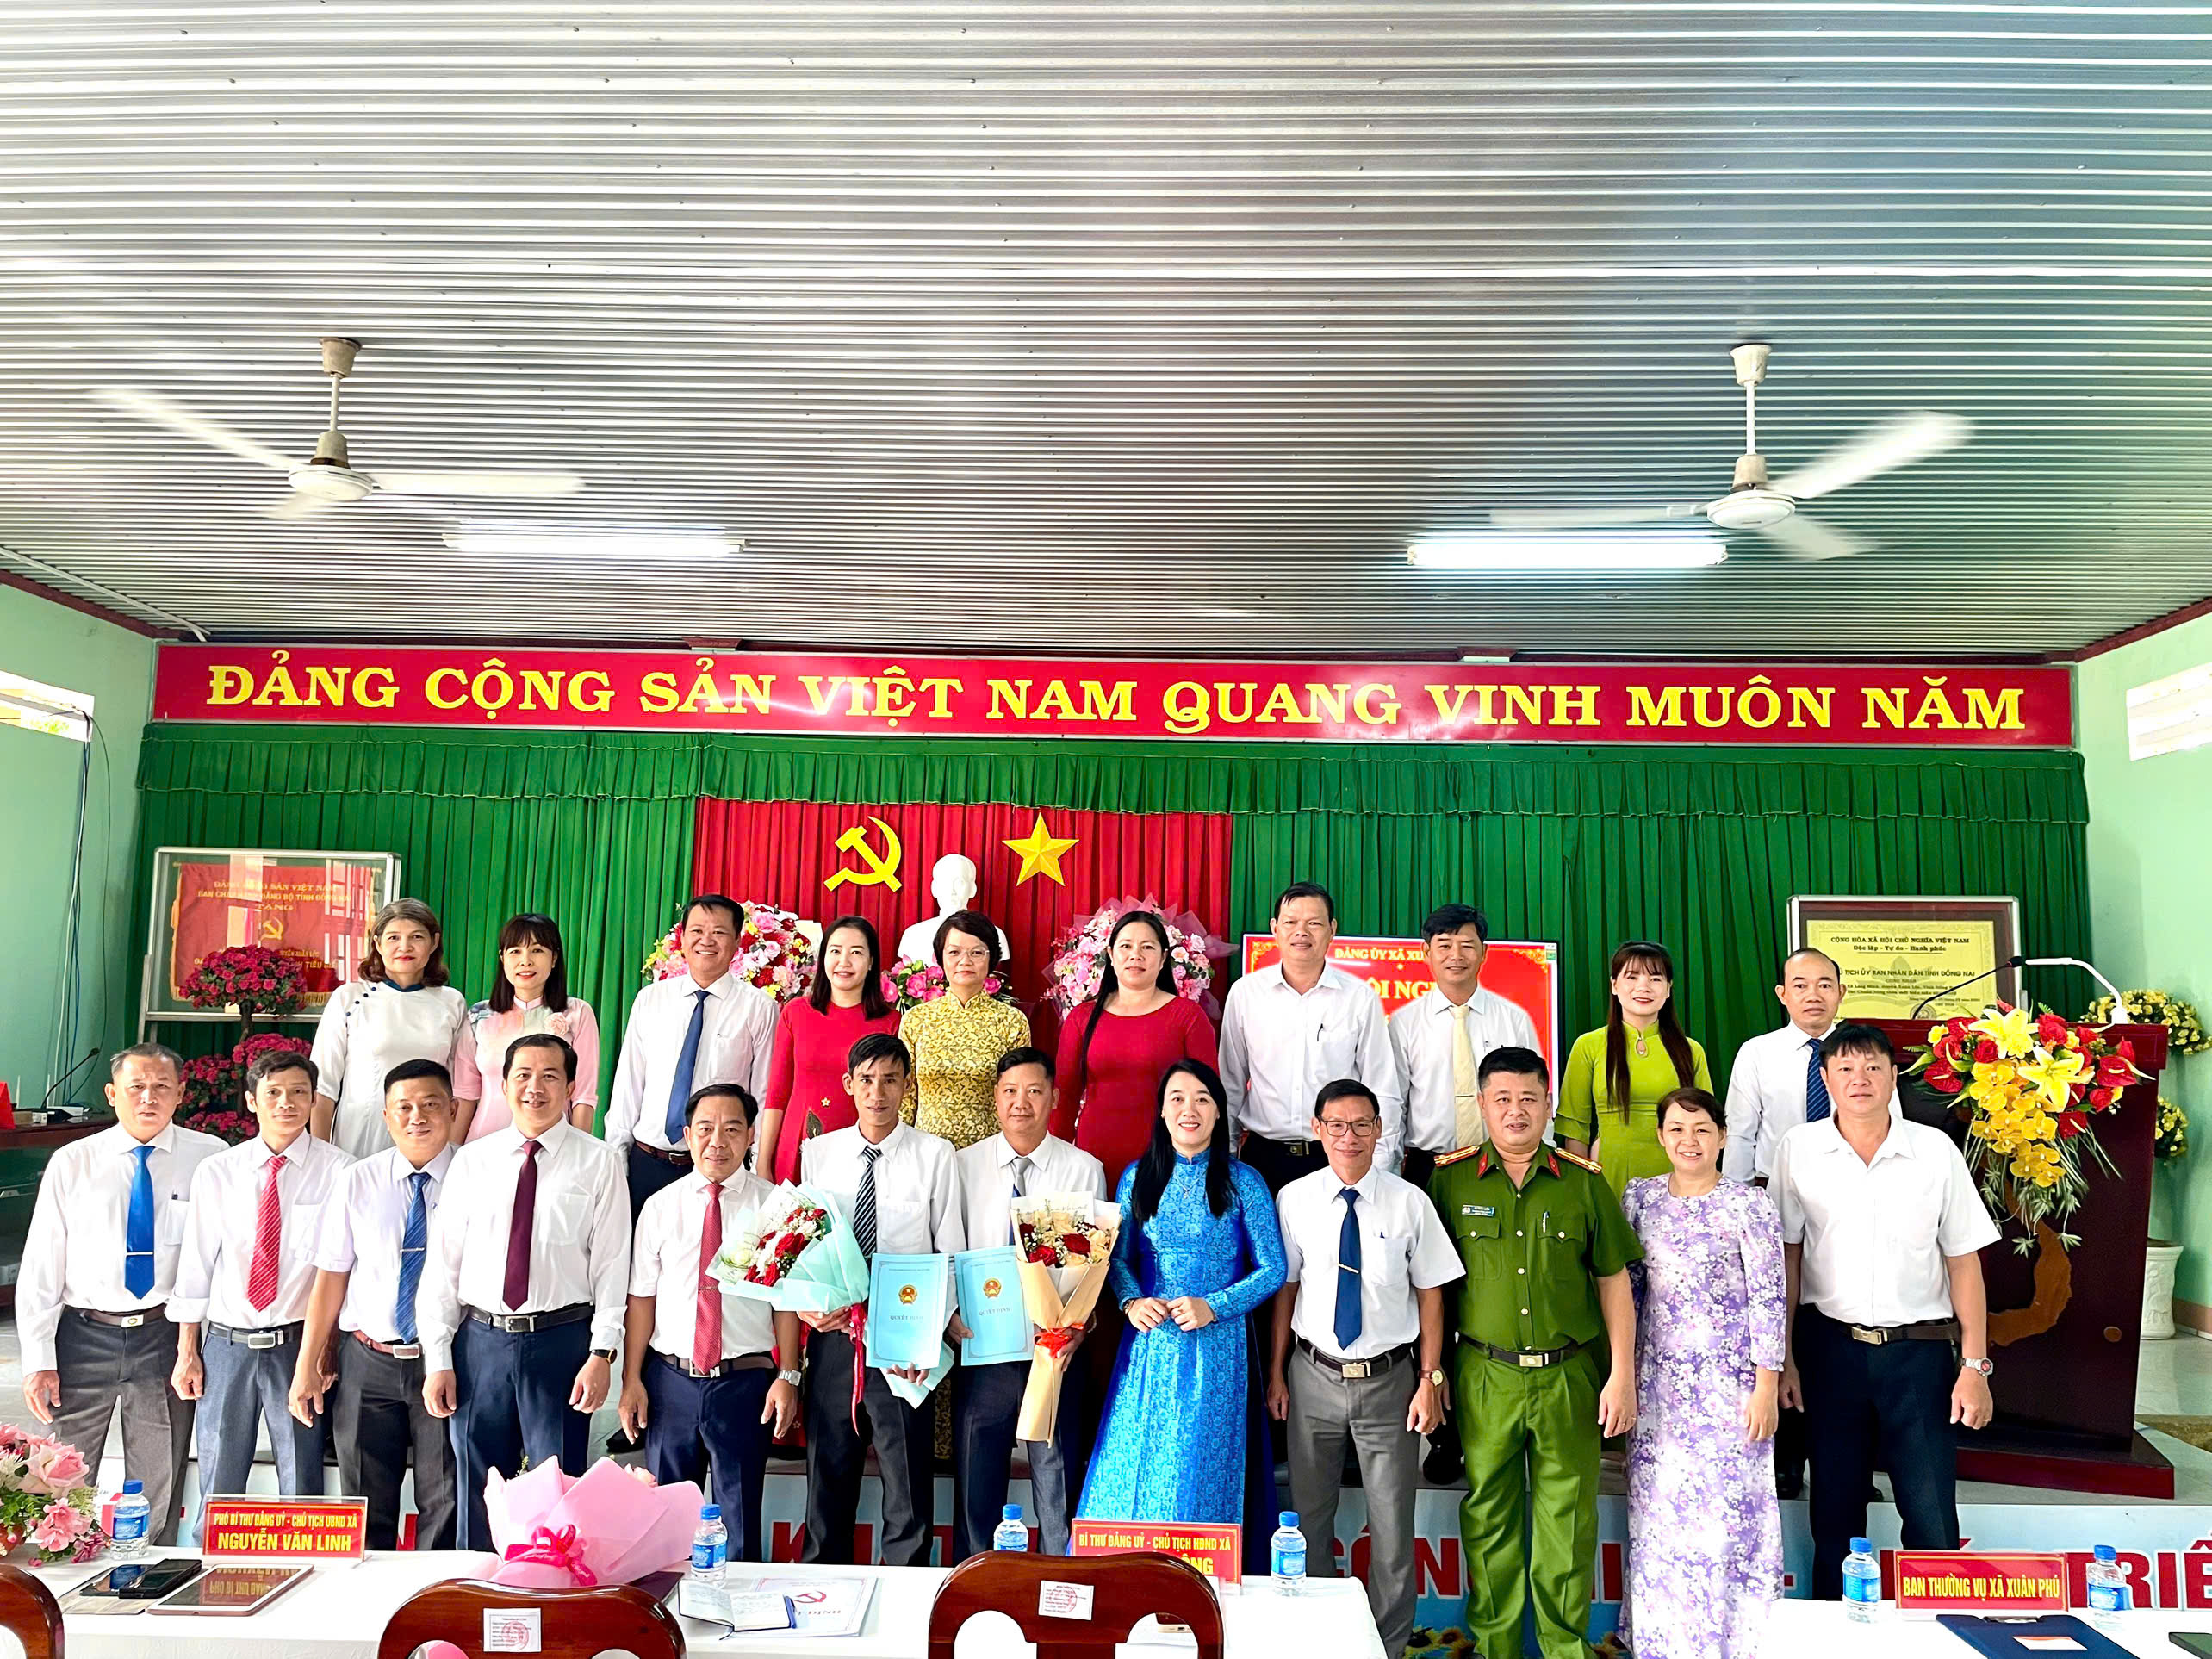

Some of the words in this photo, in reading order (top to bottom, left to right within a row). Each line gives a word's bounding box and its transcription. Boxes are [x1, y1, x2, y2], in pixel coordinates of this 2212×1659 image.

[206, 650, 400, 708] ĐẢNG
[425, 657, 616, 720] CỘNG
[640, 657, 776, 716] SẢN
[798, 666, 965, 727] VIỆT
[985, 680, 1153, 722] NAM
[1162, 681, 1401, 735] QUANG
[1424, 684, 1603, 727] VINH
[1625, 674, 1832, 729] MUÔN
[1861, 675, 2027, 730] NĂM
[1335, 946, 1369, 959] ĐẢNG
[1370, 947, 1388, 960] ỦY
[1388, 948, 1406, 960] XÃ
[1407, 950, 1426, 960] XU
[214, 1511, 228, 1526] PHÓ
[230, 1512, 239, 1526] BÍ
[239, 1513, 254, 1527] THƯ
[255, 1510, 274, 1527] ĐẢNG
[291, 1511, 307, 1527] CHỦ
[308, 1514, 325, 1530] TỊCH
[326, 1515, 345, 1528] UBND
[347, 1513, 358, 1528] XÃ
[218, 1528, 278, 1550] NGUYỄN
[282, 1531, 313, 1551] VĂN
[316, 1534, 352, 1552] LINH
[1079, 1531, 1088, 1546] BÍ
[1090, 1533, 1107, 1547] THƯ
[1108, 1531, 1132, 1548] ĐẢNG
[1153, 1532, 1171, 1549] CHỦ
[1172, 1536, 1191, 1553] TỊCH
[1193, 1538, 1217, 1550] HĐND
[1219, 1536, 1231, 1551] XÃ
[1903, 1576, 1926, 1597] BAN
[1928, 1573, 1971, 1598] THƯỜNG
[1973, 1577, 1987, 1601] VỤ
[1990, 1575, 2004, 1598] XÃ
[2006, 1575, 2036, 1598] XUÂN
[2038, 1575, 2060, 1598] PHÚ
